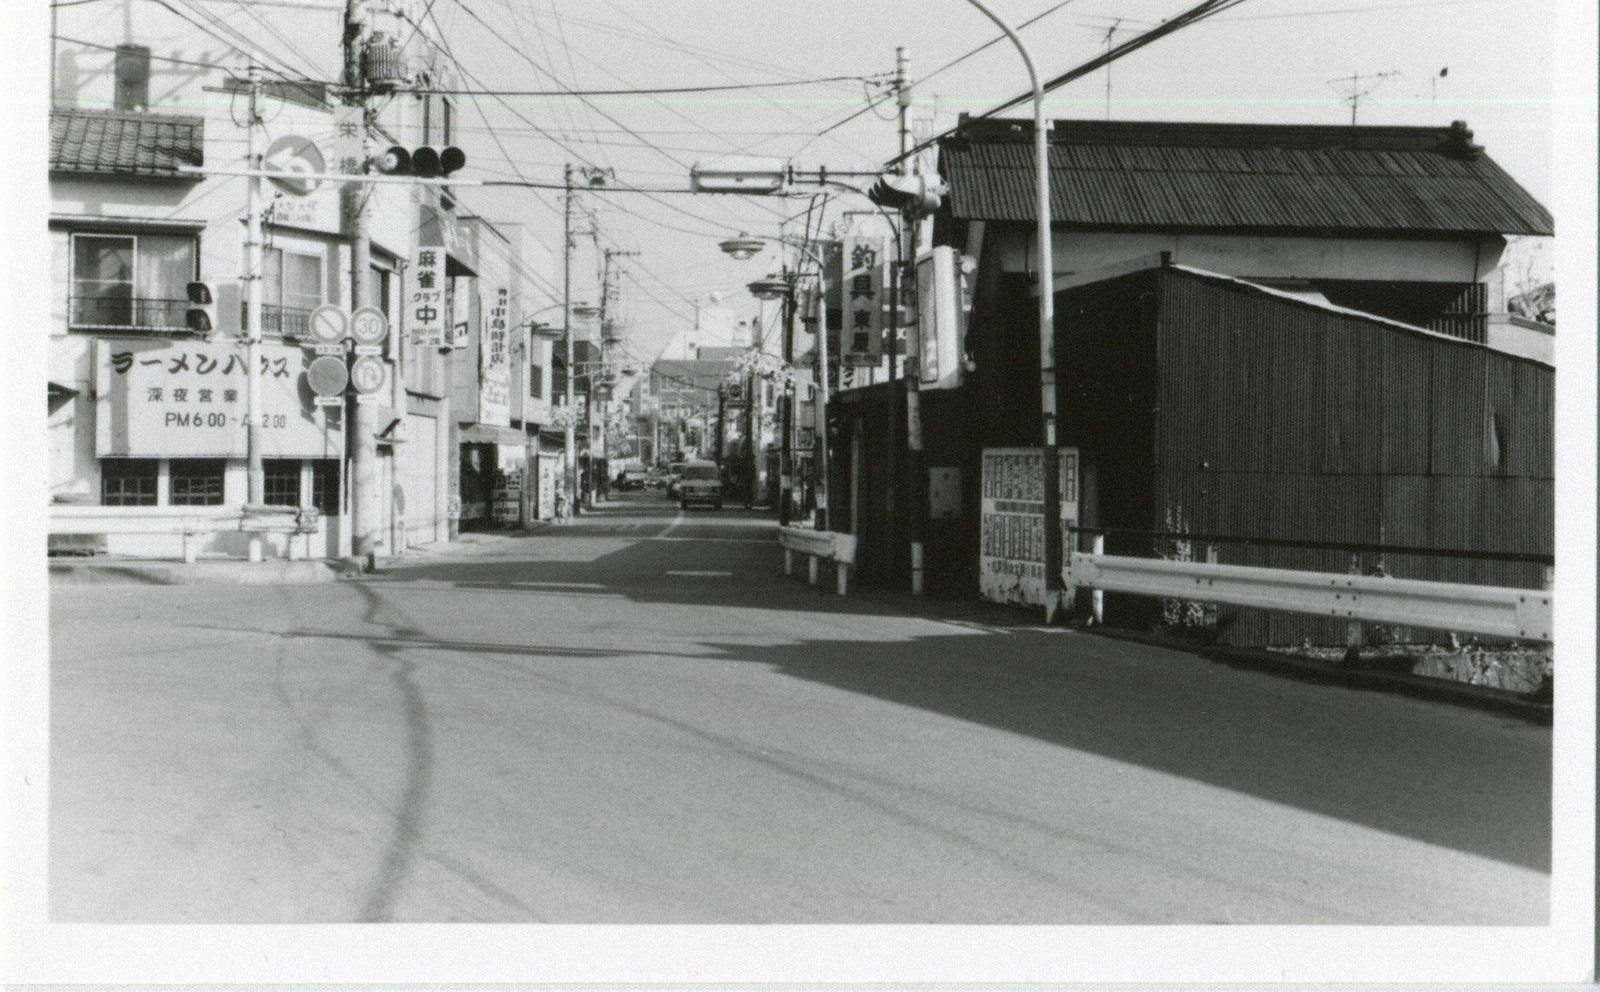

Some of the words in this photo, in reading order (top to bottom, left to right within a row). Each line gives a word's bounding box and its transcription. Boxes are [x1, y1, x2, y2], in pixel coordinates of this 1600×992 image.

[418, 251, 437, 289] 麻雀
[413, 292, 441, 302] クラブ
[415, 305, 437, 325] 中
[359, 318, 380, 334] 30
[148, 387, 238, 403] 深夜営業
